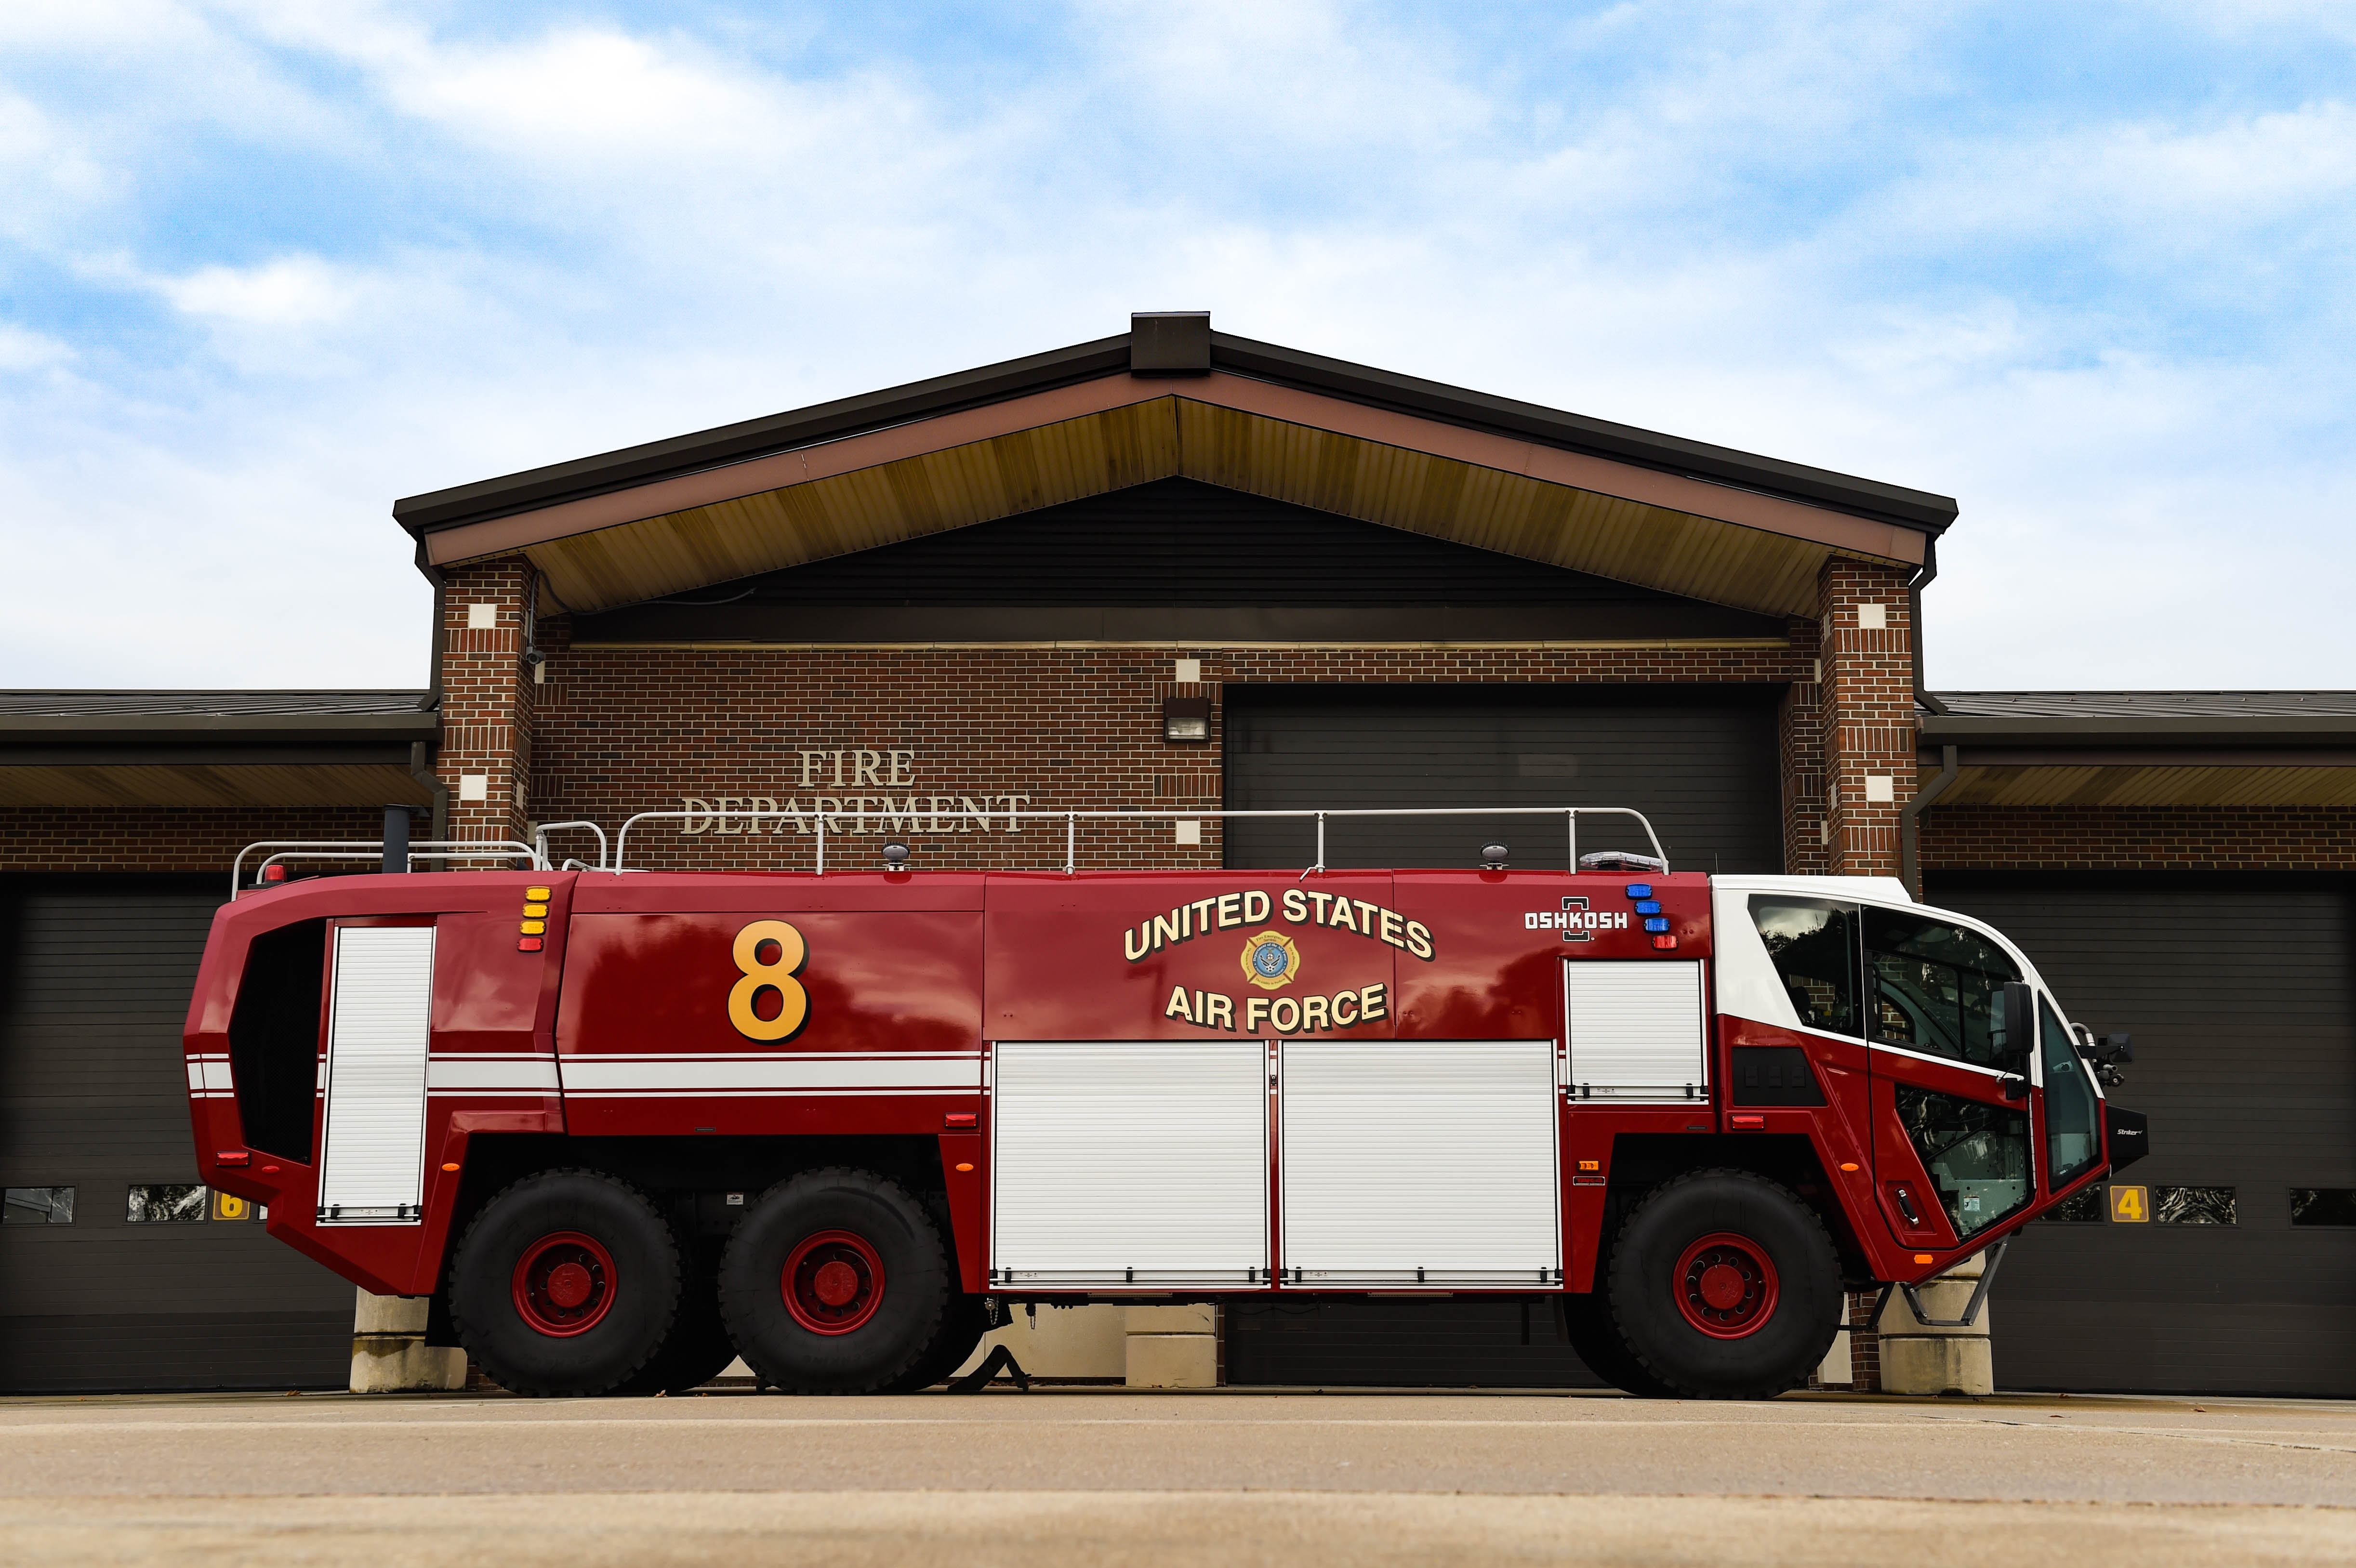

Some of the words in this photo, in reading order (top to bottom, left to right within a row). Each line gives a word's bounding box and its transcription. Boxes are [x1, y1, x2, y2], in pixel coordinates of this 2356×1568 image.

[798, 750, 915, 787] FIRE
[680, 795, 1031, 835] DEPARTMENT
[1125, 890, 1271, 961] UNITED
[1283, 889, 1433, 959] STATES
[1524, 912, 1628, 929] OSHKOSH
[1253, 943, 1267, 962] Department
[728, 921, 807, 1041] 8
[1165, 986, 1232, 1028] AIR
[1247, 983, 1385, 1031] FORCE
[221, 1193, 243, 1218] 6
[2118, 1189, 2143, 1219] 4
